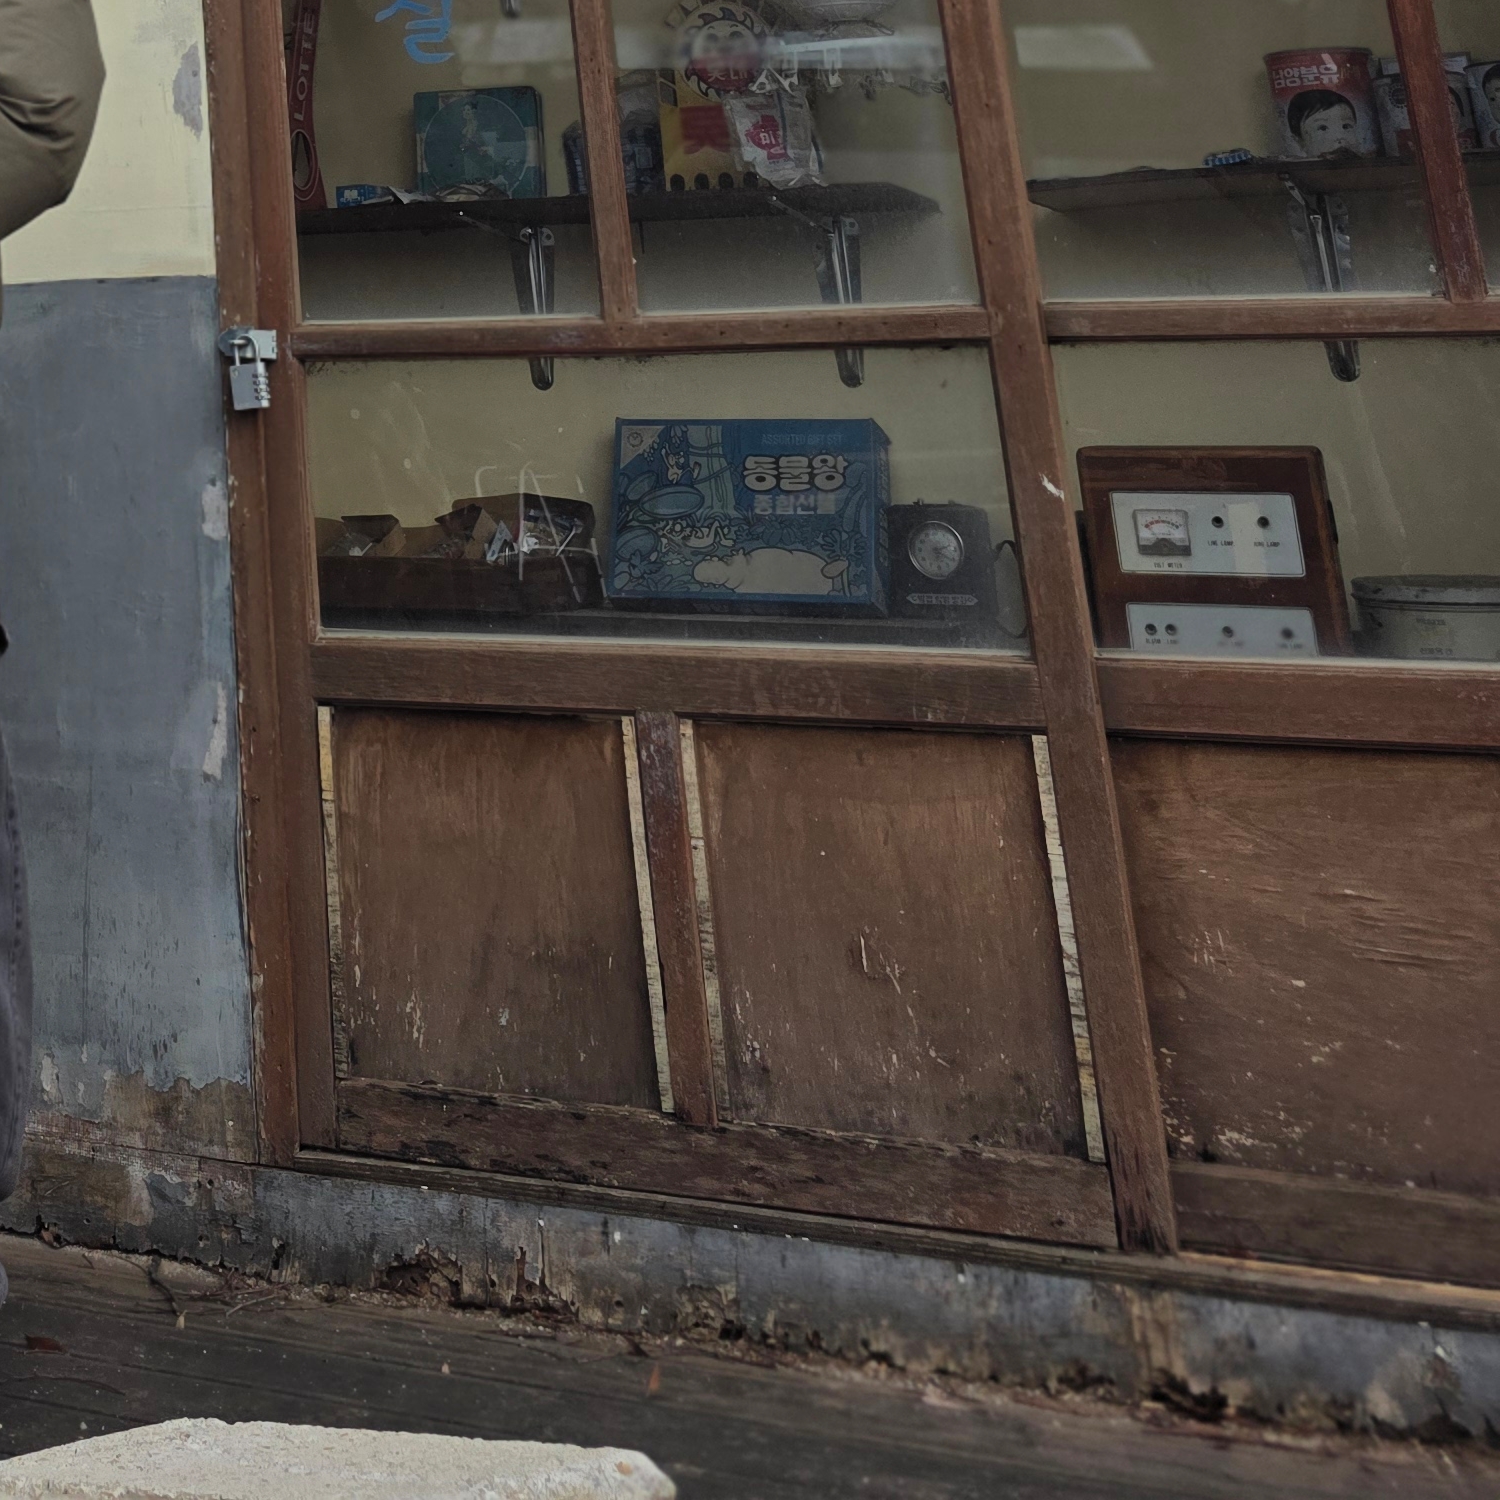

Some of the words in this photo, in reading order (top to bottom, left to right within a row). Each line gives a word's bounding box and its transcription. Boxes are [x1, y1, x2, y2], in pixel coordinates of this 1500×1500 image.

[293, 12, 316, 121] LOTTE
[1272, 64, 1340, 89] 남양분유
[742, 455, 849, 491] 동물왕
